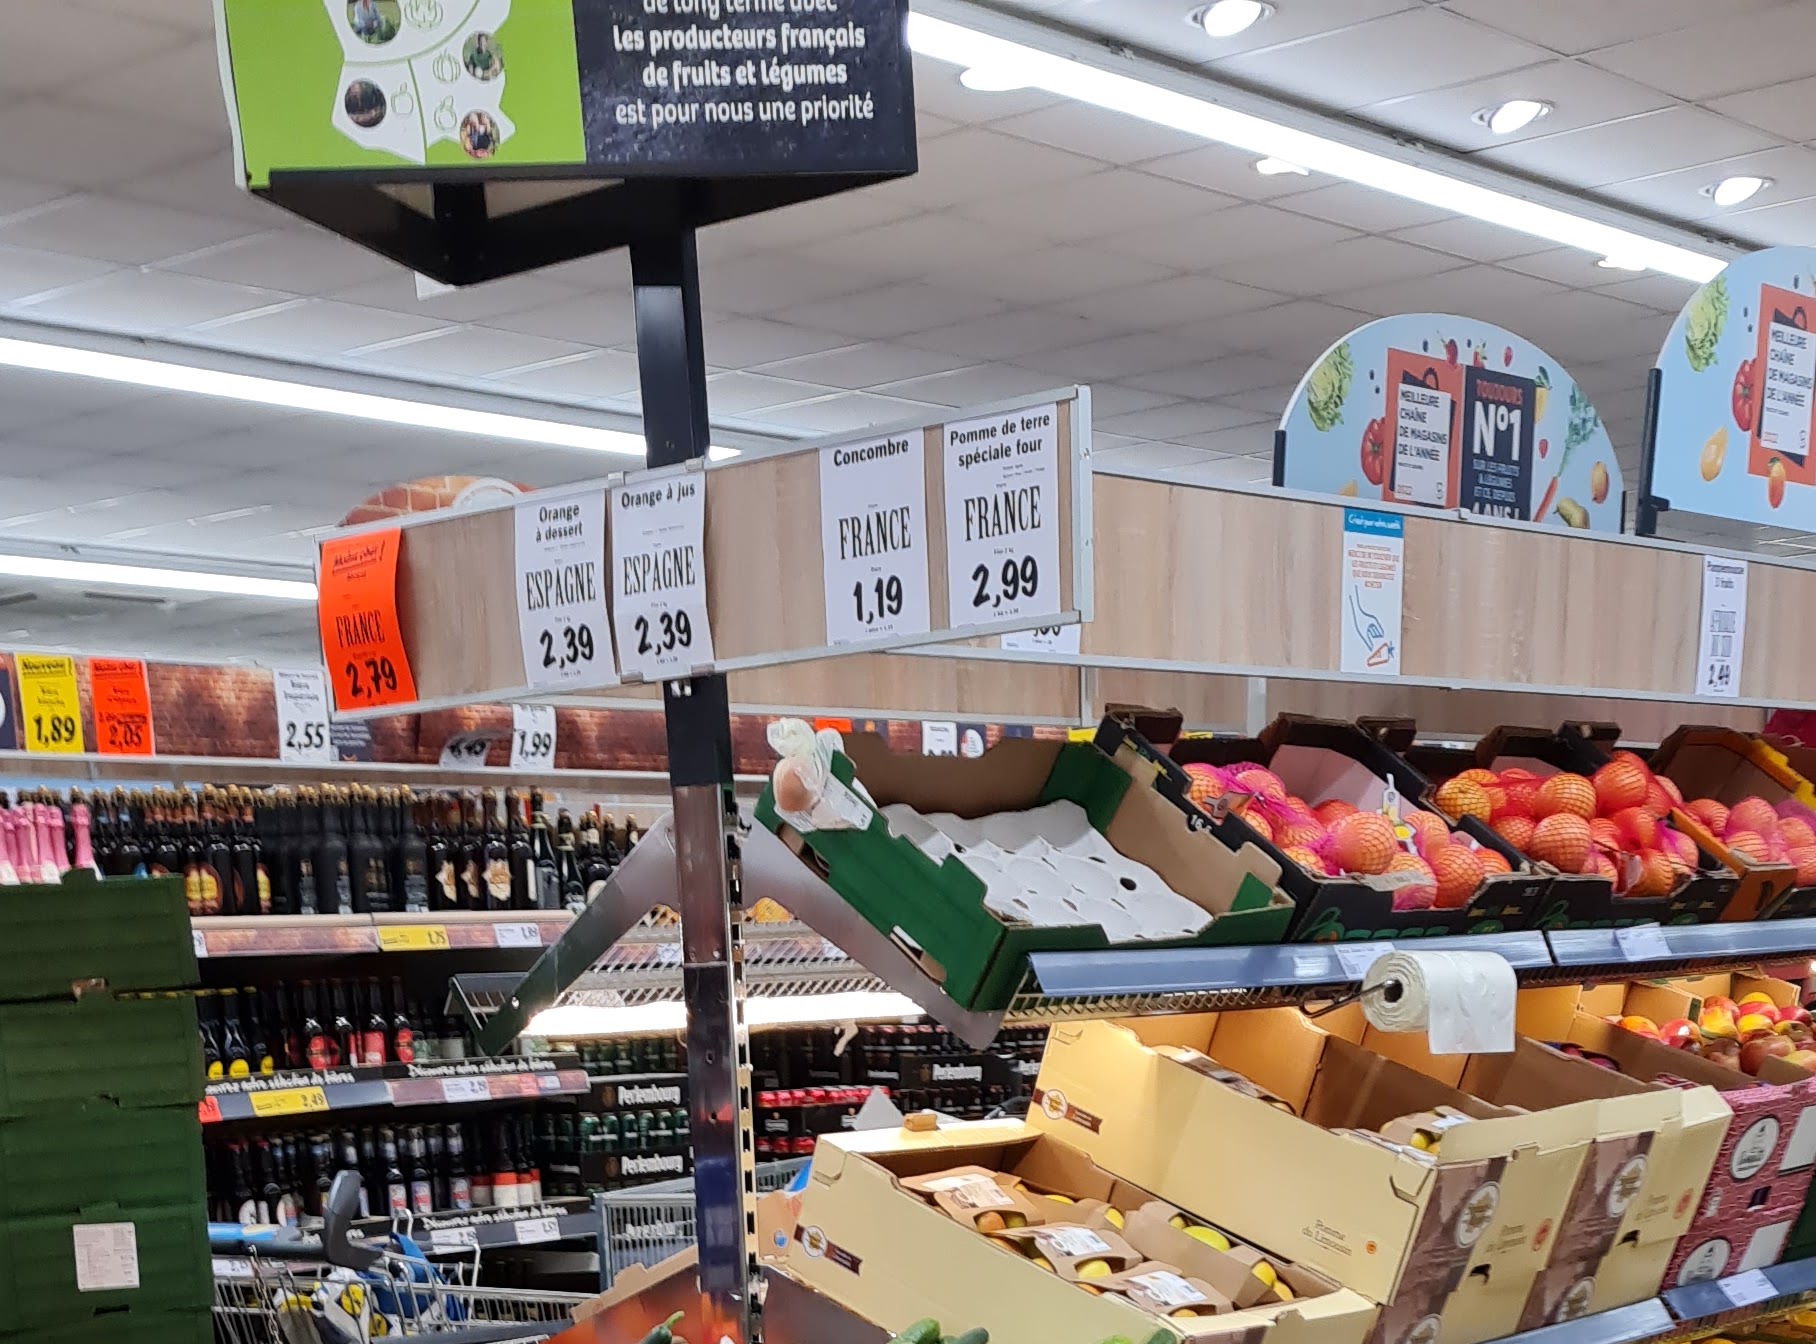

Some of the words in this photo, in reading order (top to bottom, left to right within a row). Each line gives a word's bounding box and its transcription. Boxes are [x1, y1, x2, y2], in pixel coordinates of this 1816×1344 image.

[613, 25, 645, 51] les
[649, 23, 777, 56] producteurs
[781, 21, 866, 56] français
[642, 62, 668, 87] de
[672, 60, 731, 92] fruits
[735, 60, 757, 86] et
[761, 56, 847, 92] légumes
[616, 99, 647, 125] est
[651, 102, 699, 130] pour
[704, 101, 754, 123] nous
[759, 99, 796, 121] une
[801, 91, 874, 126] priorité
[949, 426, 997, 447] Pomme
[1001, 418, 1016, 435] de
[1021, 412, 1050, 431] terre
[1473, 400, 1521, 461] N°1
[834, 438, 909, 467] Concombre
[958, 440, 1012, 470] spéciale
[1016, 436, 1043, 455] four
[539, 503, 580, 523] Orange
[621, 488, 662, 511] Orange
[667, 483, 673, 501] à
[677, 482, 696, 503] jus
[964, 485, 1042, 542] FRANCE
[536, 526, 542, 543] à
[545, 521, 583, 542] dessert
[838, 506, 912, 560] FRANCE
[525, 561, 597, 611] ESPAGNE
[623, 545, 696, 597] ESPAGNE
[972, 555, 1039, 608] 2,99
[853, 574, 903, 625] 1,19
[335, 609, 386, 648] FRANCE
[539, 623, 594, 670] 2,39
[634, 609, 693, 656] 2,39
[346, 656, 398, 699] 2,79
[33, 713, 76, 748] 1,89
[286, 721, 325, 751] 2,55
[518, 732, 553, 760] 1,99
